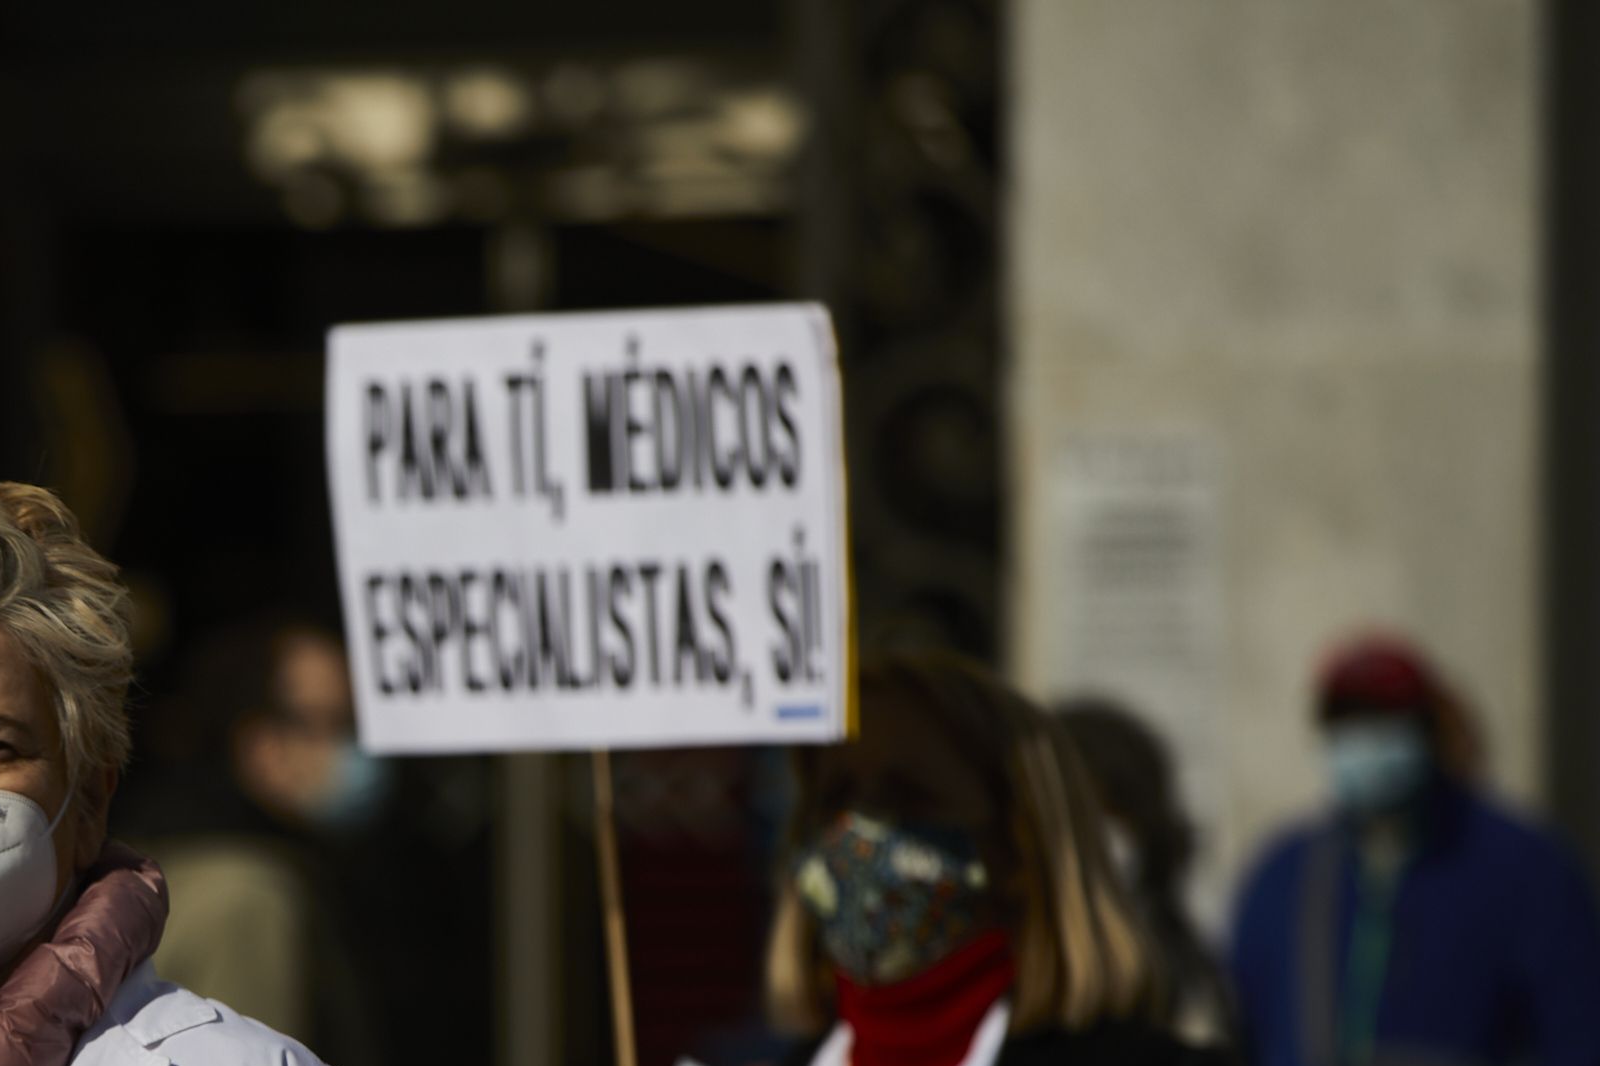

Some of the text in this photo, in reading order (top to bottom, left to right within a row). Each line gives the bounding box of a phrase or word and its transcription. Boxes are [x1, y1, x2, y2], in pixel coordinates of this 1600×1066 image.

[363, 375, 493, 506] PARA
[583, 332, 801, 496] MÉDICOS
[364, 558, 754, 710] ESPECIALISTAS,
